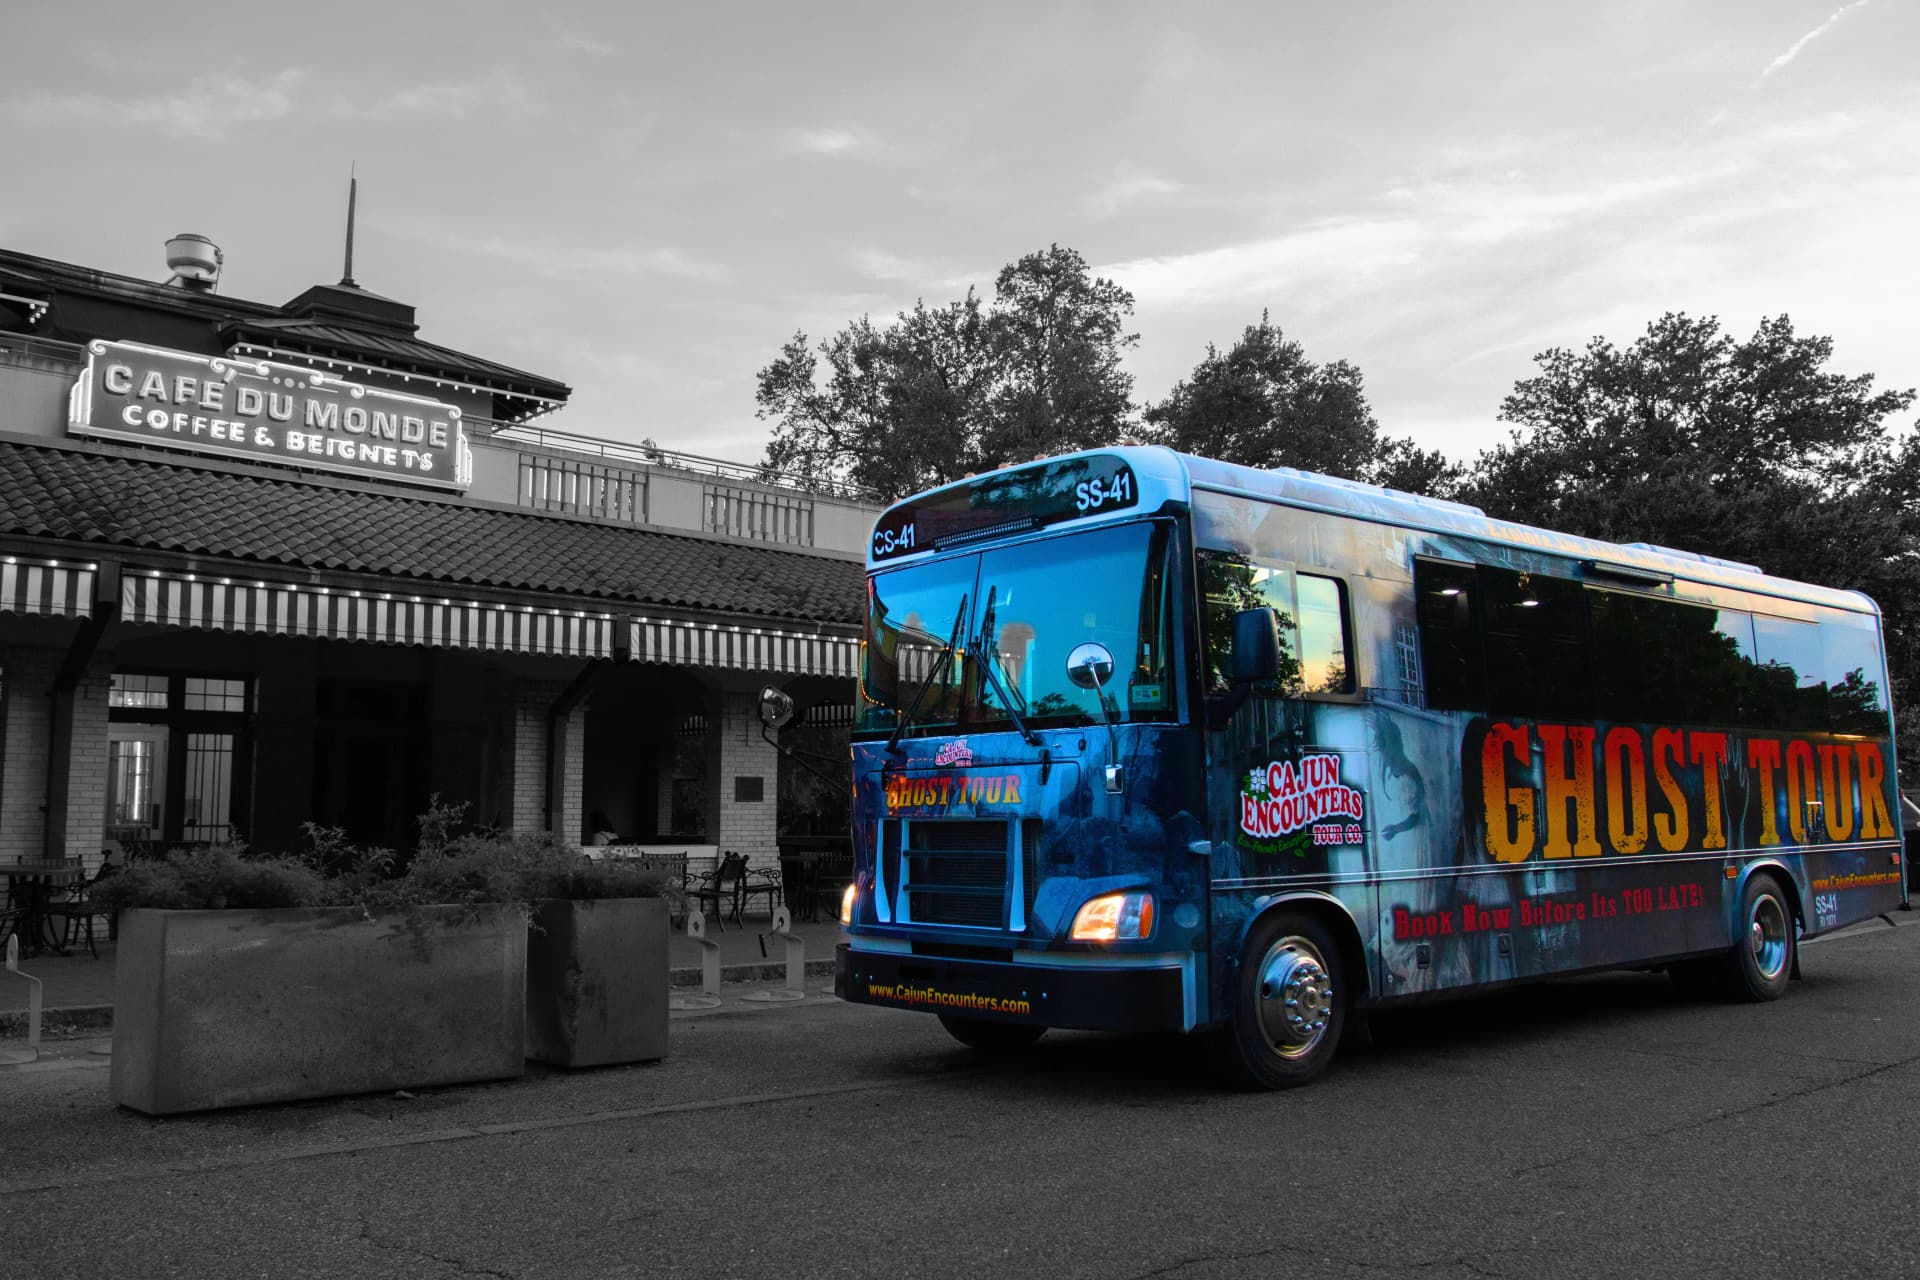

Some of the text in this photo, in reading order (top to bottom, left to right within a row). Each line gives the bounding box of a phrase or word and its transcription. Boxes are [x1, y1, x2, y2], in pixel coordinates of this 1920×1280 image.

[121, 404, 433, 472] COFFEE & BEIGNETS
[237, 386, 293, 421] DU
[305, 399, 449, 449] MONDE
[1076, 472, 1131, 510] SS-41
[885, 774, 1020, 808] GHOST TOUR
[1267, 756, 1340, 798] CAJUN
[1482, 721, 1895, 863] GHOST TOUR
[1241, 786, 1363, 836] ENCOUNTERS
[1313, 824, 1343, 845] TOUR
[1345, 824, 1363, 844] CO.
[1462, 904, 1511, 933] Now
[1520, 896, 1586, 927] Before
[1592, 891, 1617, 919] Its
[1622, 886, 1653, 915] TOO
[1815, 892, 1838, 914] SS-41
[868, 984, 1031, 1015] www.CajunEncounters.com
